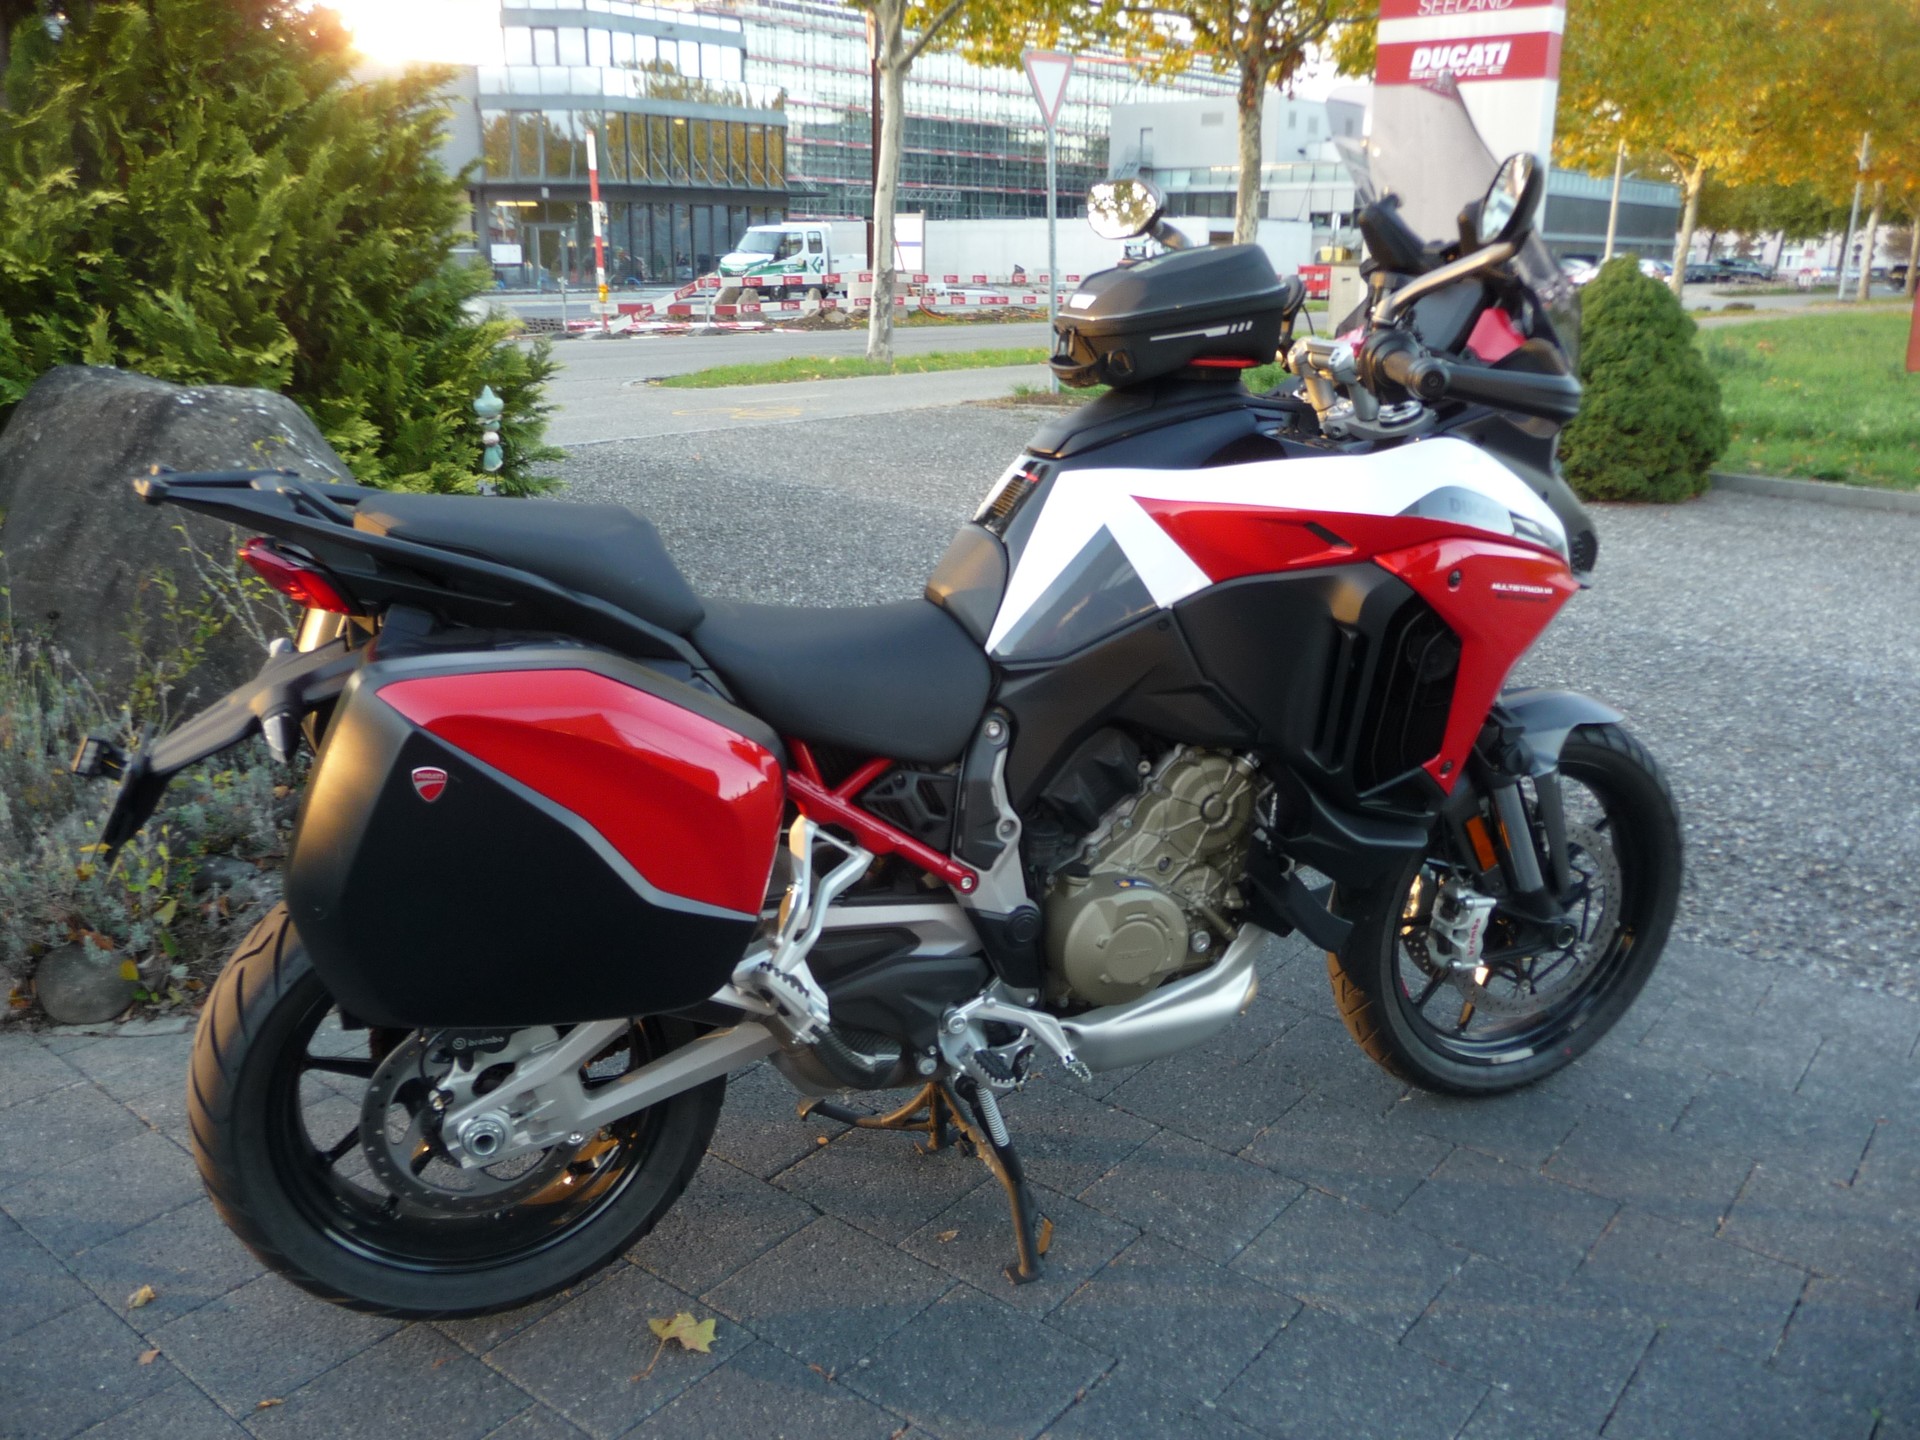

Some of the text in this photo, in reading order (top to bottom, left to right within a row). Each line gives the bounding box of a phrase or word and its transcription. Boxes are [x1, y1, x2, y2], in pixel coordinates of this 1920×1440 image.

[1417, 0, 1513, 15] SEELAND
[1410, 41, 1512, 70] DUCATI
[1467, 918, 1481, 956] brembo
